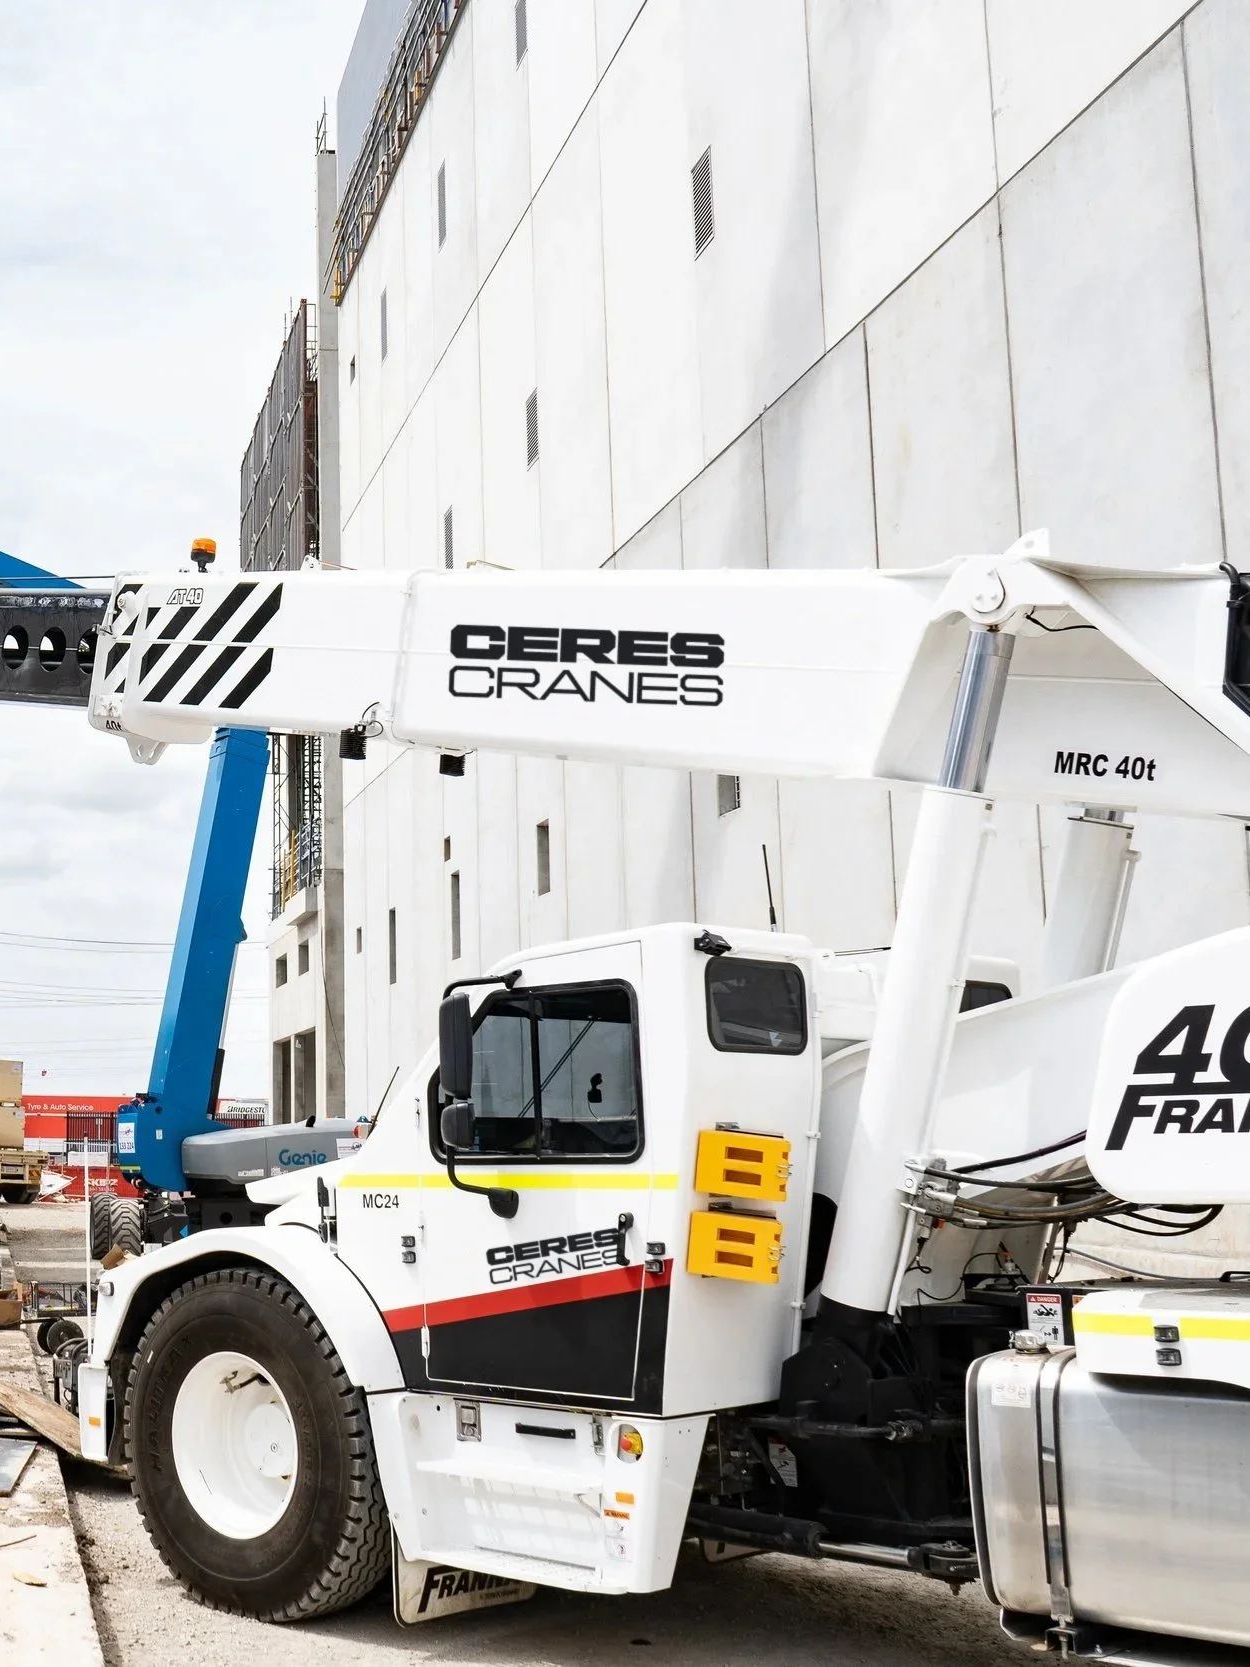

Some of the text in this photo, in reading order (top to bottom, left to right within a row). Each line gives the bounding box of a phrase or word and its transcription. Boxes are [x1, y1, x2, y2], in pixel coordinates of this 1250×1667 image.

[166, 587, 204, 605] AT40
[450, 624, 725, 668] CERES
[448, 665, 724, 706] CRANES
[1054, 751, 1157, 781] MRC 40t
[27, 1103, 41, 1111] Tyre
[49, 1103, 67, 1111] Auto
[67, 1103, 94, 1111] Service
[278, 1148, 328, 1167] Genie
[362, 1193, 400, 1209] MC24
[486, 1227, 619, 1266] CERES
[489, 1248, 618, 1285] CRANES
